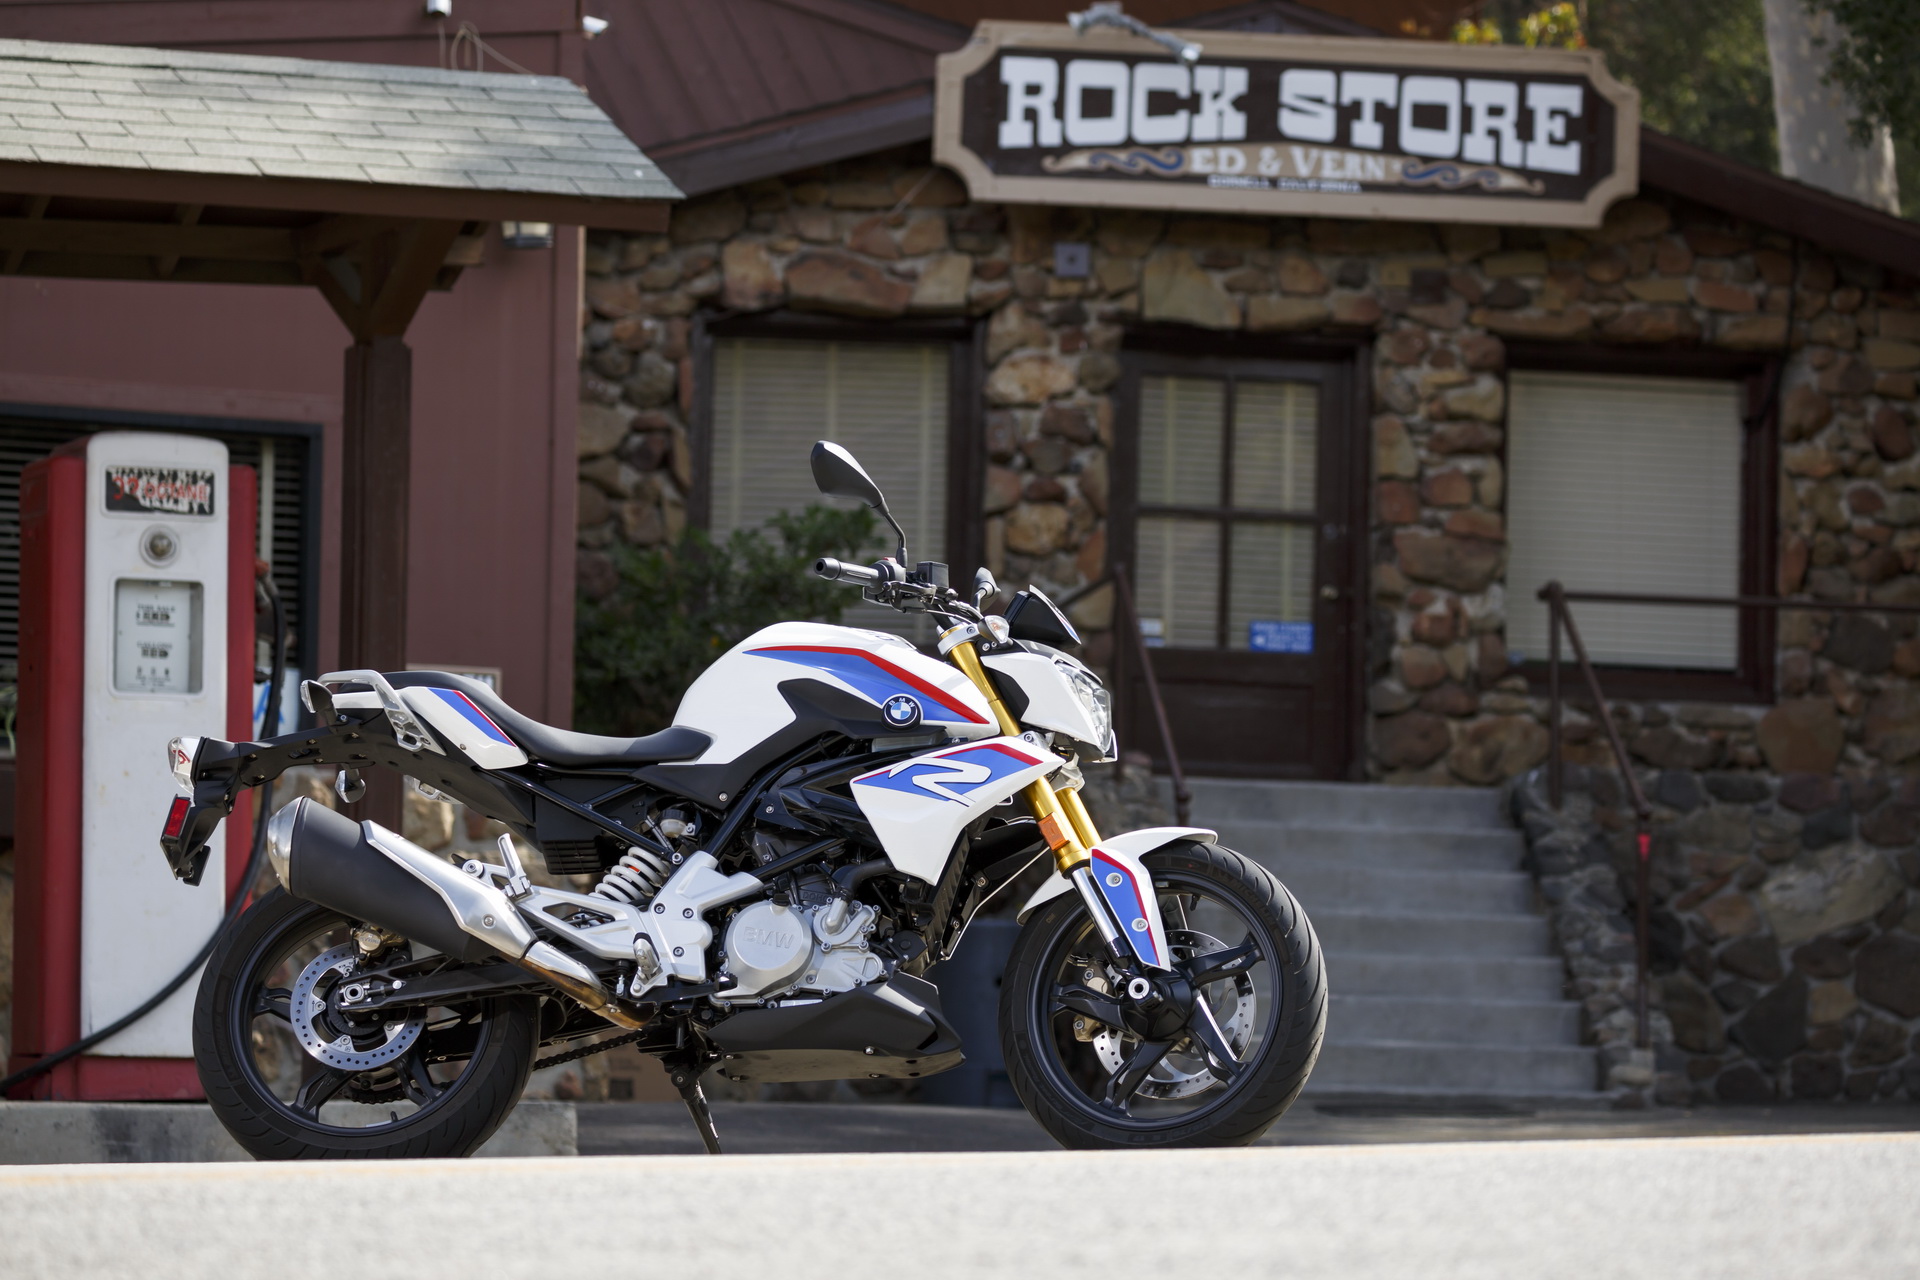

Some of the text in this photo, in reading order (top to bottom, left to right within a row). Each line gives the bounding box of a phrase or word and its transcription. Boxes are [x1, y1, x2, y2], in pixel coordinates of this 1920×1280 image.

[999, 56, 1583, 175] ROCK STORE
[1191, 147, 1246, 174] ED
[1258, 147, 1283, 177] &
[889, 697, 916, 708] BMW
[743, 926, 795, 949] BMW
